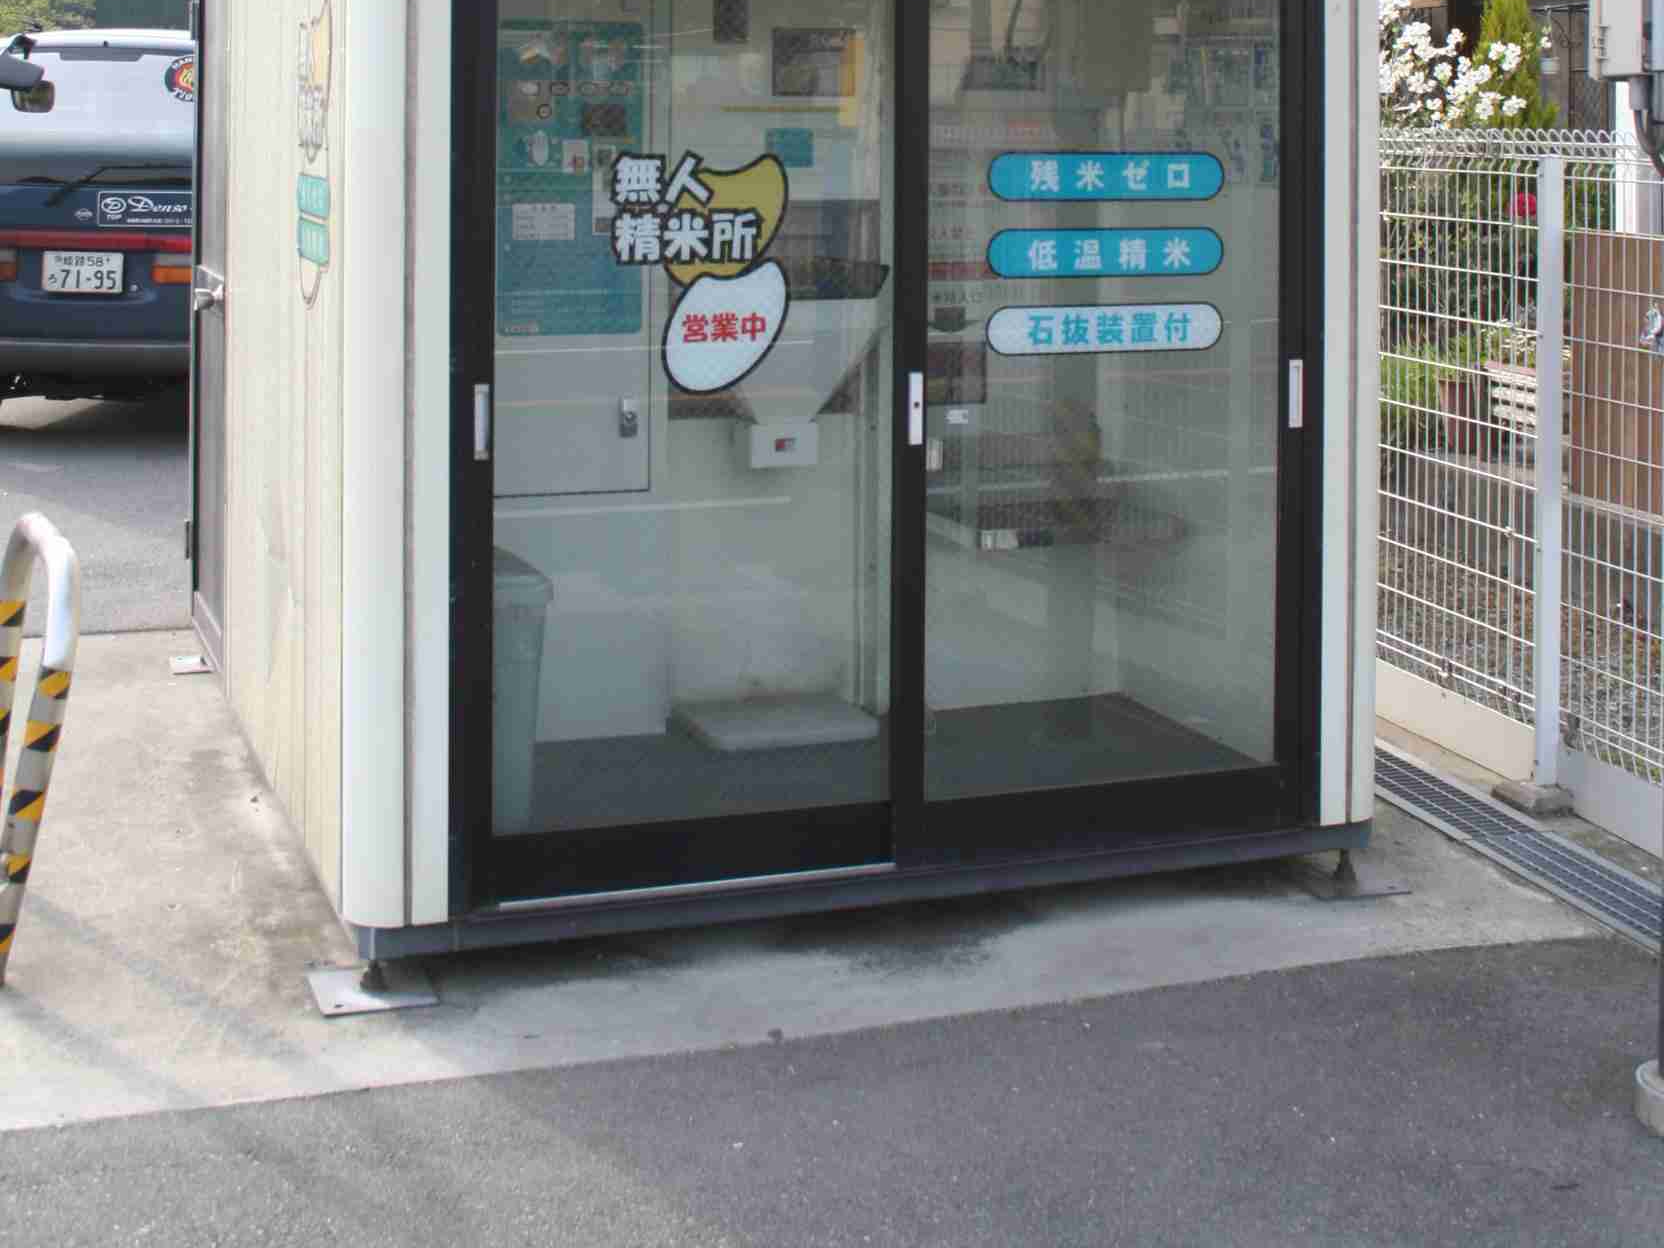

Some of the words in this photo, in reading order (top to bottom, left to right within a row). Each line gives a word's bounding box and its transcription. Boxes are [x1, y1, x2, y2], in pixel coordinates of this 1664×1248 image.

[615, 155, 714, 204] 無人
[1029, 159, 1190, 193] 残米ゼロ
[615, 211, 758, 262] 精米所
[1027, 237, 1191, 271] 低温精米
[60, 268, 117, 290] 71-95
[681, 311, 768, 344] 営業中
[1027, 311, 1192, 346] 石抜装置付
